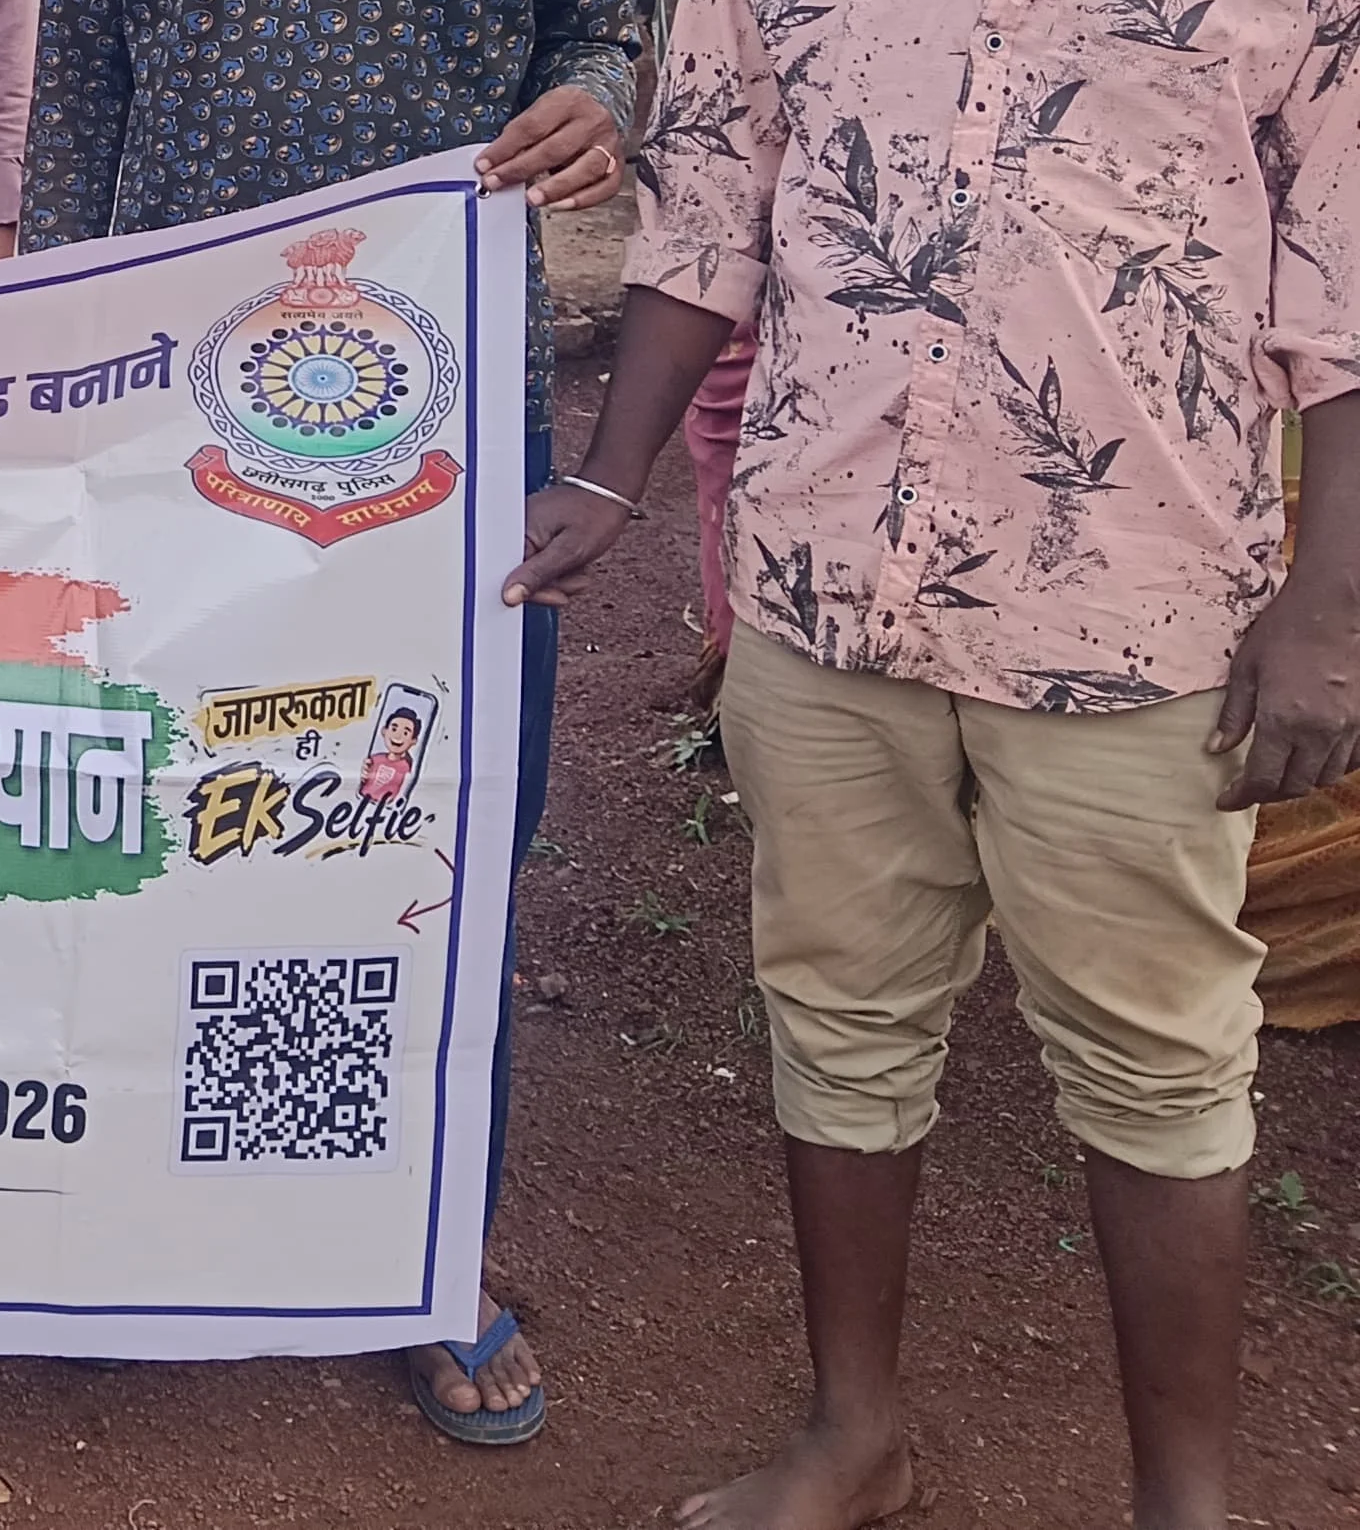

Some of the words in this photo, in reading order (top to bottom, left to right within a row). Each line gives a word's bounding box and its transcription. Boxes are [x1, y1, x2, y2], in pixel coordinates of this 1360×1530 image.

[26, 332, 178, 414] बनाने
[336, 473, 396, 496] पुलिस
[213, 680, 372, 738] जागरूकता
[295, 729, 322, 760] ही
[272, 770, 423, 857] Selfie
